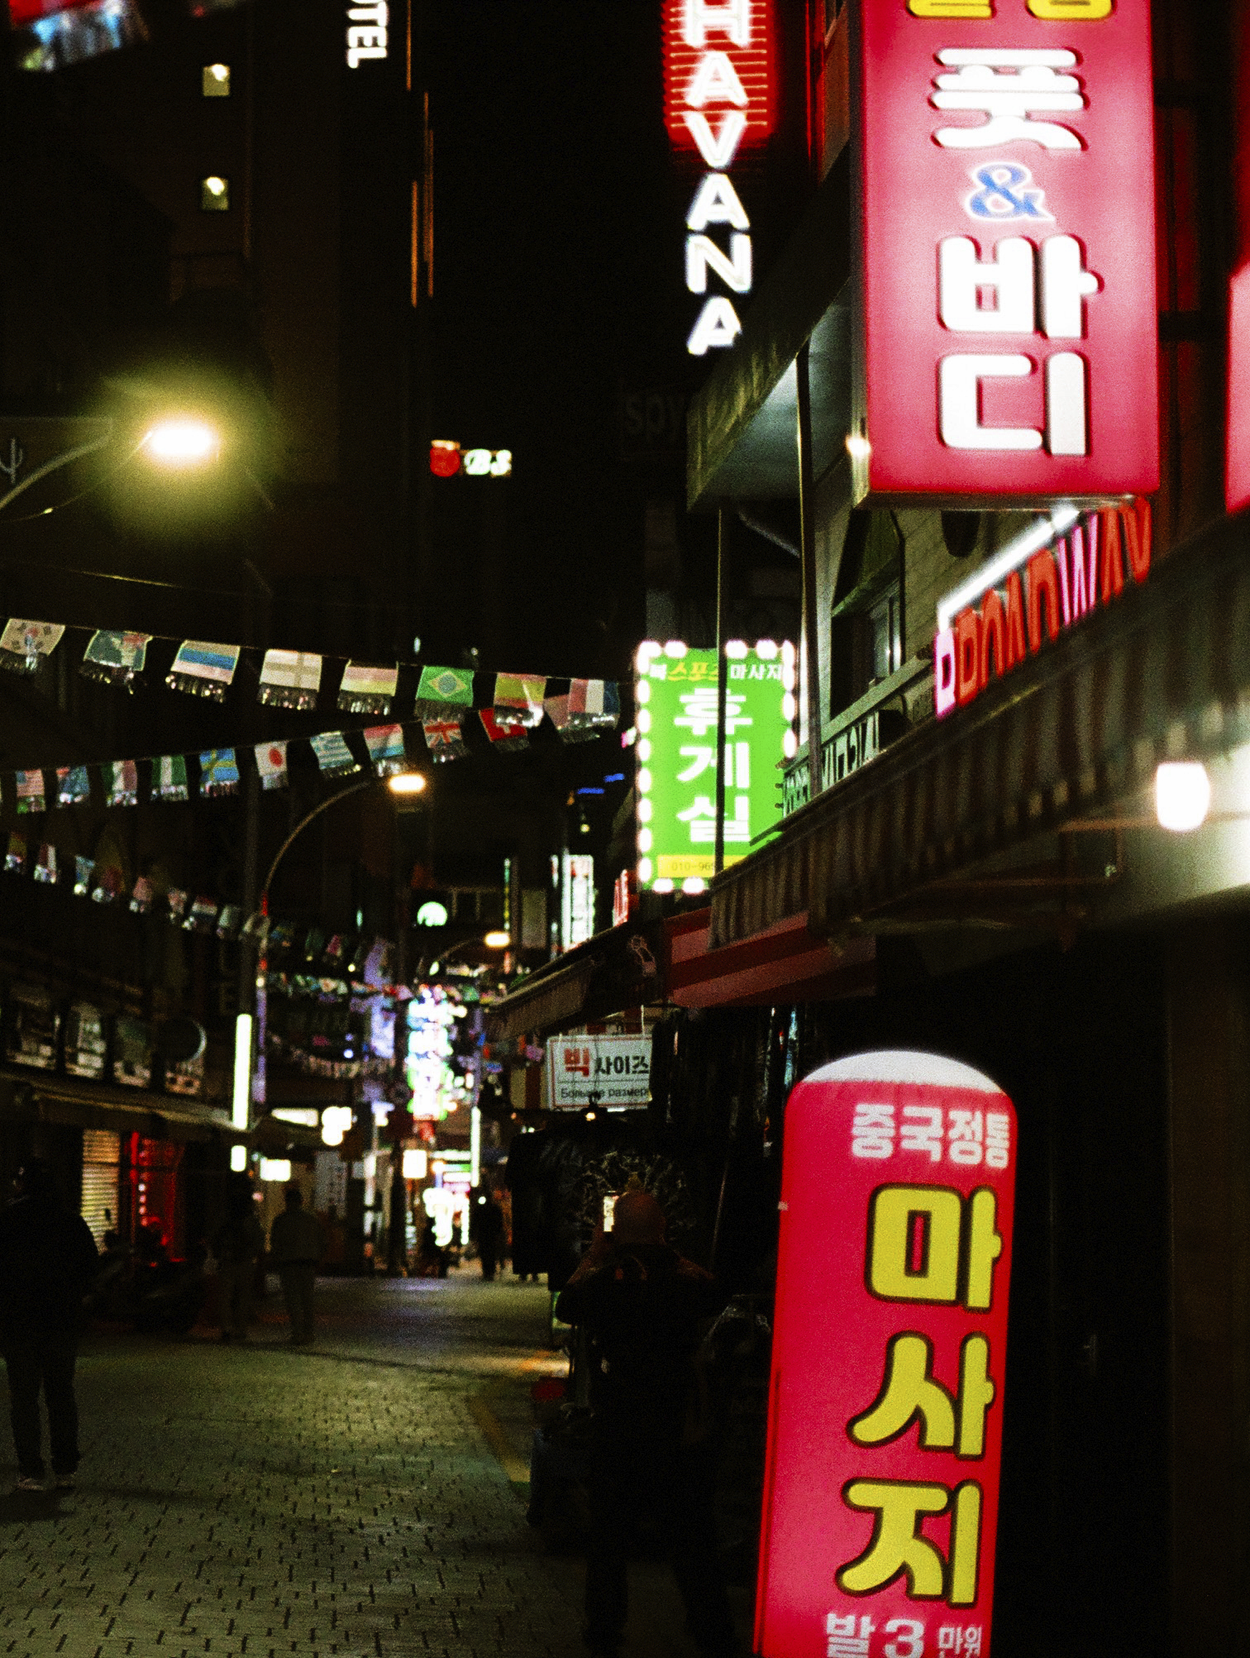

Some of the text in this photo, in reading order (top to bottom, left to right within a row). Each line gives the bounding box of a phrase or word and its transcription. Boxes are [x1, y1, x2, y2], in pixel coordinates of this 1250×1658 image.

[346, 0, 389, 69] TEL
[684, 0, 753, 355] HAVANA
[674, 687, 754, 843] 휴게실
[564, 1047, 649, 1077] 빅 사이즈
[851, 1103, 1010, 1169] 중국정통
[836, 1182, 1003, 1610] 마사지
